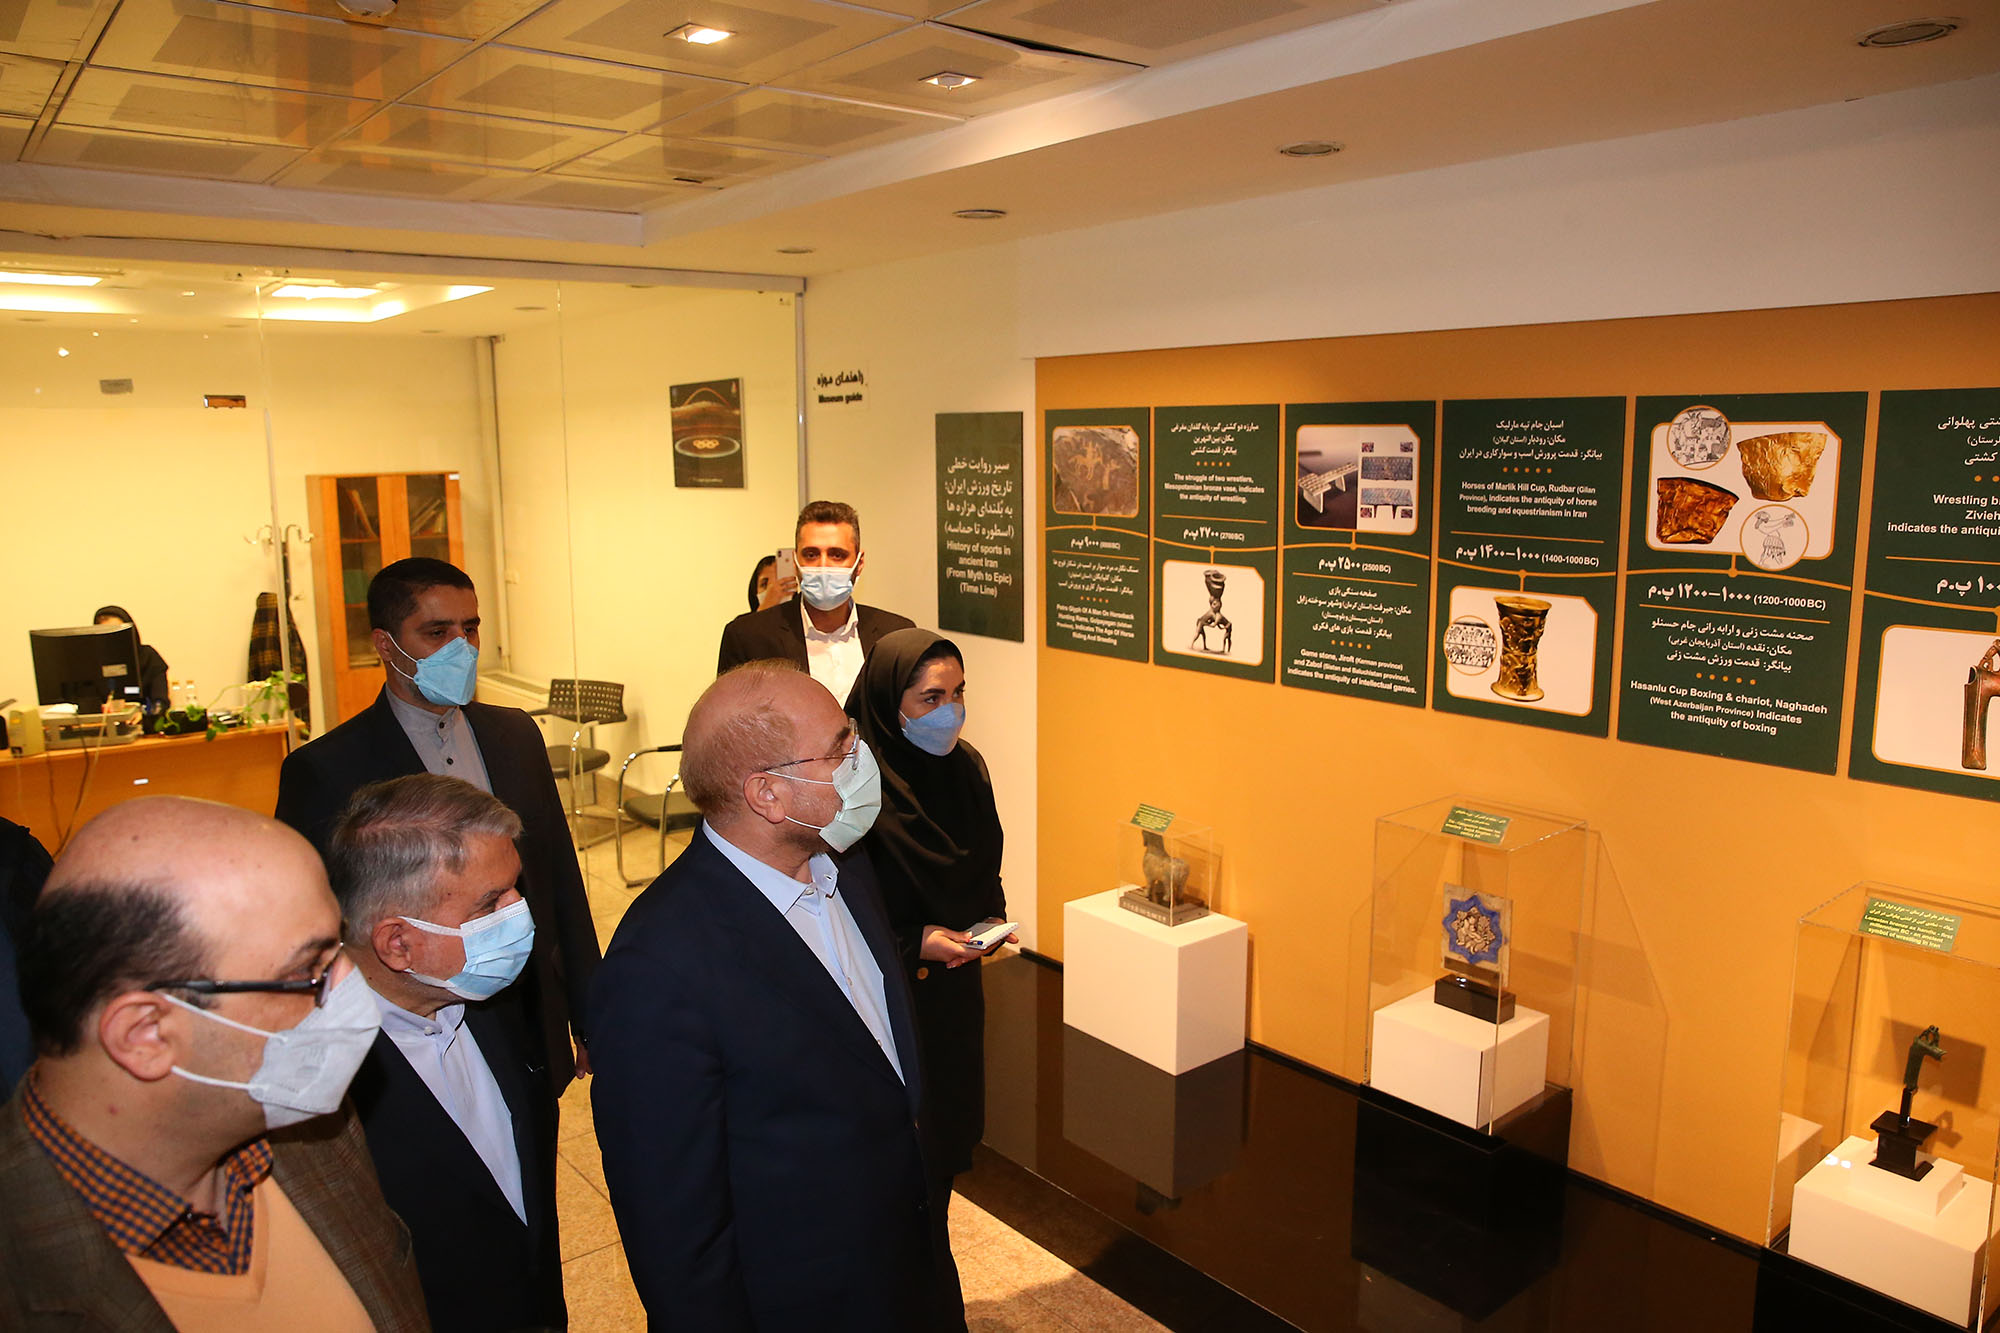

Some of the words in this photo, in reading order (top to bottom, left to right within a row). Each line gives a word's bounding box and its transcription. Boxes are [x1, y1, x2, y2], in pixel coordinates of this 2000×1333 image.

[1938, 416, 1976, 430] پهلوانی
[1964, 452, 1998, 465] کشتی
[948, 457, 968, 474] خطی
[968, 457, 992, 474] روایت
[993, 463, 1010, 474] سیر
[967, 480, 990, 496] ورزش
[991, 480, 1013, 496] تاریخ
[1462, 481, 1486, 490] Horses
[1487, 482, 1495, 490] of
[1496, 482, 1516, 491] Marlik
[1518, 483, 1529, 491] Hill
[1548, 484, 1576, 493] Rudbar
[946, 500, 955, 512] ها
[1534, 496, 1565, 506] antiquity
[1576, 498, 1597, 506] horse
[1933, 494, 1988, 507] Wrestling
[956, 500, 976, 516] هزاره
[1005, 505, 1013, 518] به
[1467, 505, 1497, 515] breeding
[1498, 506, 1511, 514] and
[1512, 507, 1562, 517] equestrianism
[1564, 509, 1571, 517] in
[1572, 509, 1588, 518] Iran
[974, 522, 980, 535] تا
[1888, 522, 1937, 534] indicates
[1940, 524, 1958, 534] the
[946, 540, 971, 554] History
[972, 542, 980, 552] of
[980, 544, 1003, 556] sports
[1004, 545, 1011, 556] in
[958, 556, 984, 567] ancient
[985, 557, 998, 568] Iran
[946, 567, 966, 579] (From
[968, 569, 984, 582] Myth
[985, 572, 993, 582] to
[994, 572, 1012, 586] Epic)
[960, 582, 979, 594] (Time
[980, 584, 998, 598] Line)
[1651, 618, 1680, 629] حسنلو
[1680, 620, 1697, 632] جام
[1698, 622, 1716, 634] رانی
[1717, 624, 1735, 635] ارابه
[1736, 629, 1741, 637] و
[1742, 626, 1759, 638] زنی
[1760, 627, 1785, 639] مشت
[1786, 631, 1814, 642] صحنه
[1688, 638, 1721, 650] آذربایجان
[1746, 642, 1765, 653] نقده
[1666, 650, 1682, 661] زنی
[1684, 652, 1706, 662] مشت
[1708, 654, 1733, 667] ورزش
[1734, 657, 1760, 668] قدمت
[1630, 680, 1667, 693] Hasanlu
[1669, 685, 1688, 698] Cup
[1690, 688, 1724, 702] Boxing
[1726, 692, 1734, 702] &
[1736, 693, 1773, 708] chariot,
[1776, 699, 1828, 715] Naghadeh
[1650, 696, 1672, 707] (West
[1672, 698, 1714, 713] Azerbaijan
[1716, 705, 1755, 719] Province)
[1670, 711, 1686, 721] the
[1687, 714, 1729, 728] antiquity
[1730, 719, 1742, 730] of
[1743, 722, 1778, 736] boxing
